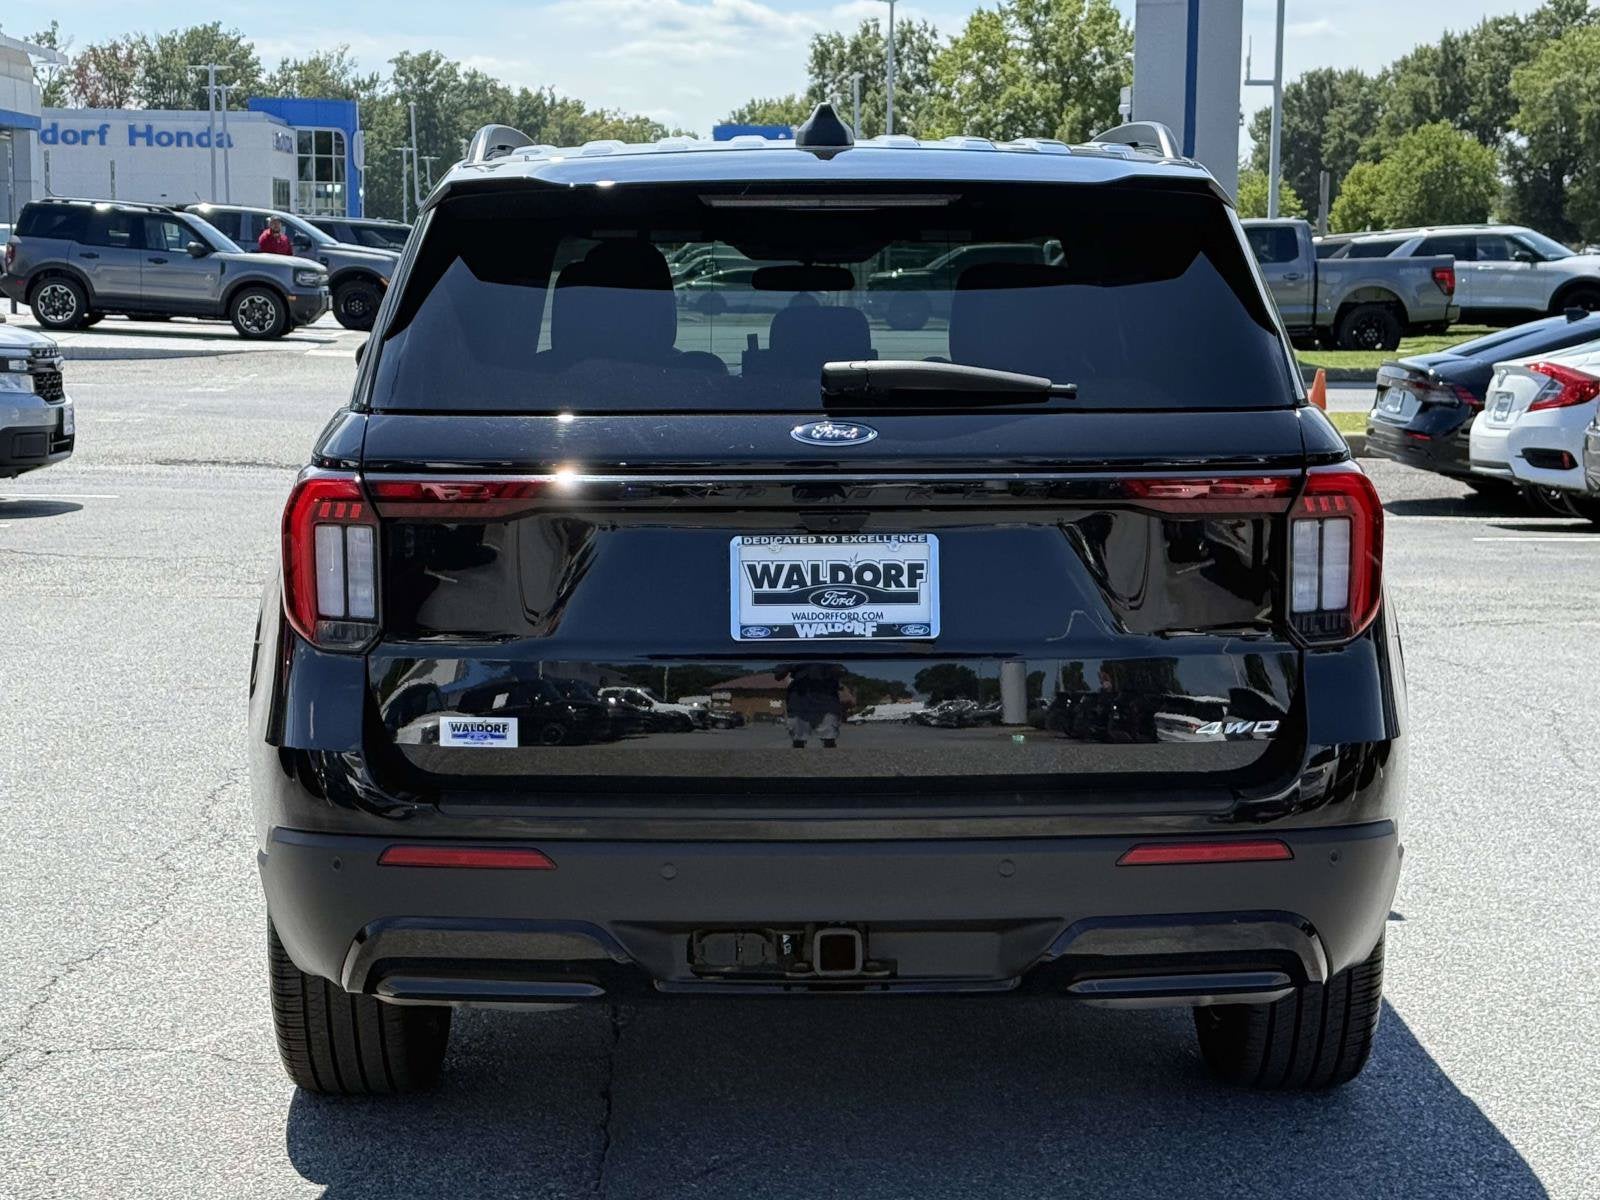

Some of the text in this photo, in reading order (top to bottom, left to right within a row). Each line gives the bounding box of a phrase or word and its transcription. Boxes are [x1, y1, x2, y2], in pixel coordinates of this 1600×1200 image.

[40, 122, 234, 148] dorf Honda
[811, 423, 859, 439] Ford
[743, 534, 926, 545] DEDICATED TO EXCELLENCE
[746, 560, 926, 590] WALDORF
[819, 590, 857, 607] Ford
[791, 611, 884, 621] WALDORFFORD.COM
[793, 620, 878, 638] WALDORF
[450, 723, 509, 733] WALDORF
[1195, 720, 1280, 734] 4WD
